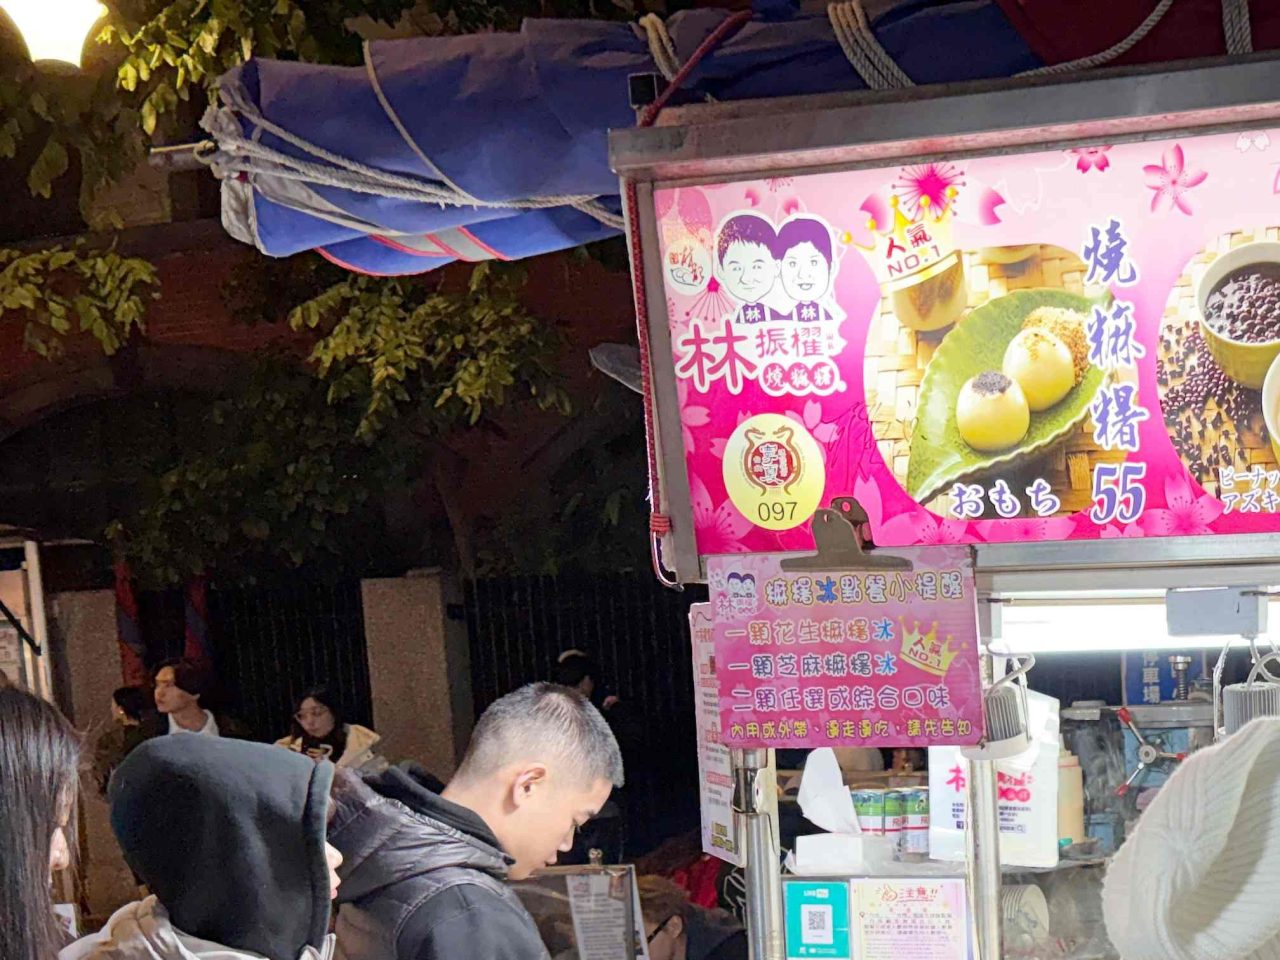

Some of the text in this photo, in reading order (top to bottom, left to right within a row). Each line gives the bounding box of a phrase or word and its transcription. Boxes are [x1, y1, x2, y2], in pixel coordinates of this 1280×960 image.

[884, 224, 932, 258] 人氣
[887, 247, 942, 275] NO.1
[953, 484, 1060, 518] おもち
[1091, 466, 1146, 522] 55
[758, 502, 798, 522] 097
[733, 685, 950, 712] 二顆任選或綜合口味
